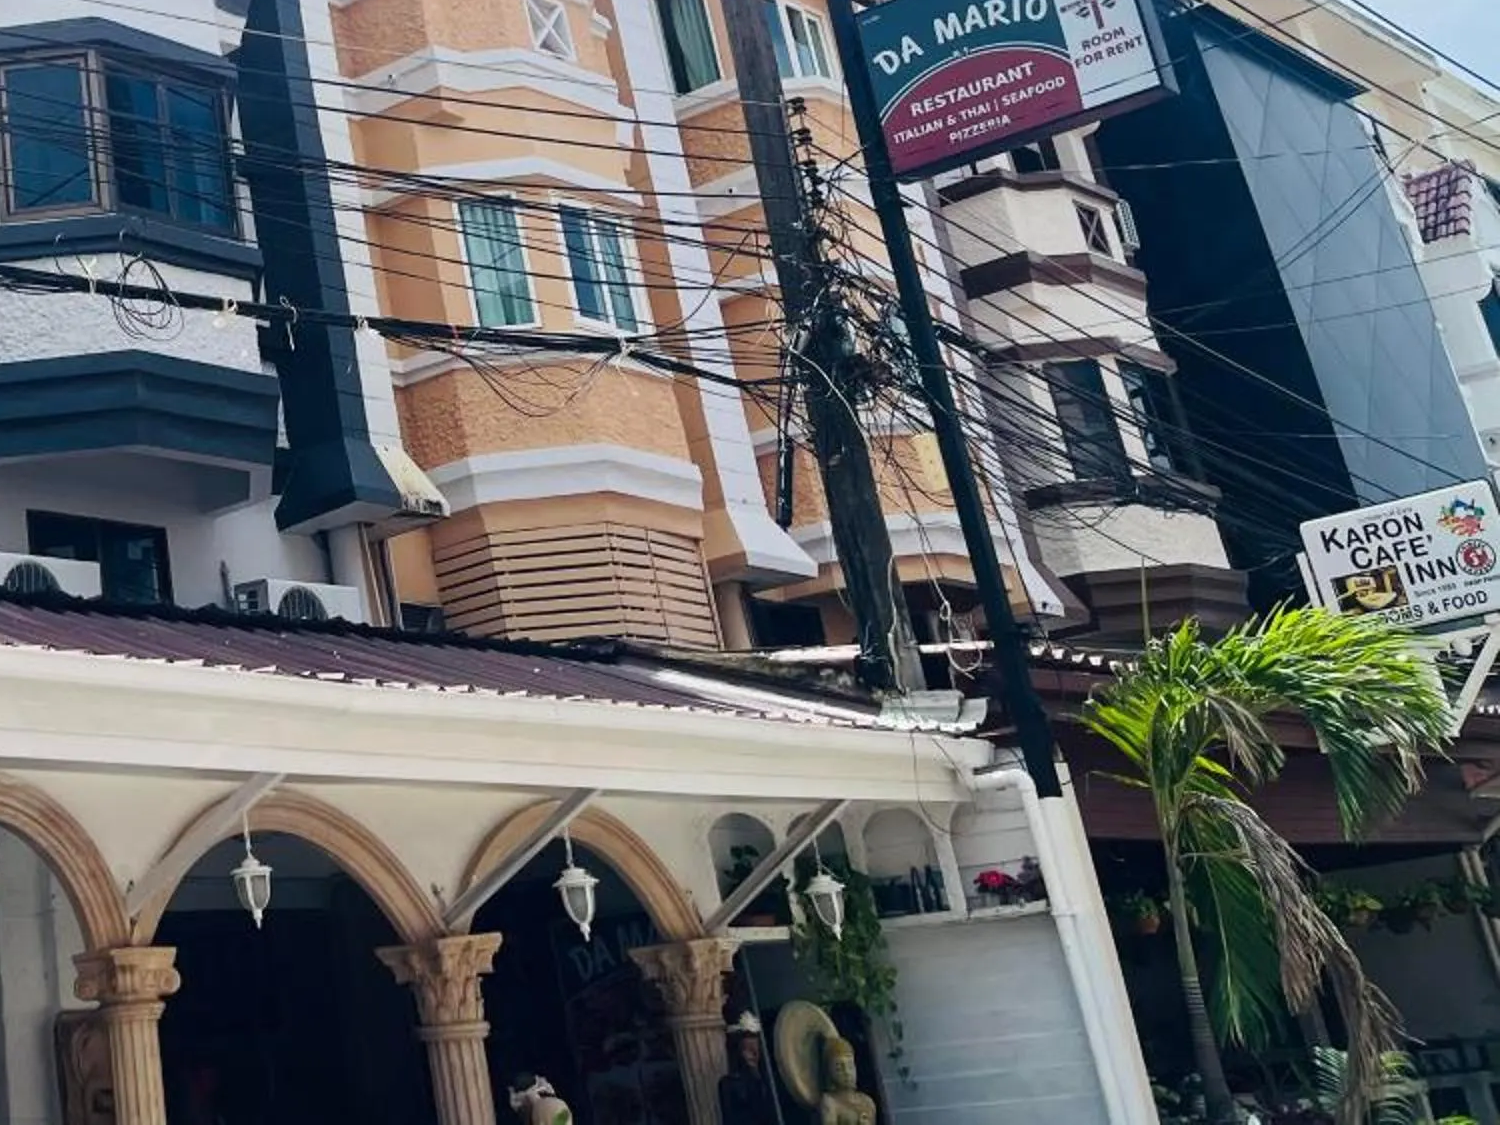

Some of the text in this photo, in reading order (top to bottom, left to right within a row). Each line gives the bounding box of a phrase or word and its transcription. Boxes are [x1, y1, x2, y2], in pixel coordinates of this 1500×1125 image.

[872, 35, 925, 75] DA
[1074, 34, 1143, 68] FOR RENT
[1080, 26, 1125, 51] ROOM
[910, 61, 1034, 117] RESTAURANT
[893, 119, 943, 144] ITALIAN
[947, 112, 957, 126] &
[959, 101, 991, 122] THAI
[1002, 76, 1066, 106] SEAFOOD
[949, 115, 1011, 144] PIZZERIA
[1320, 512, 1424, 553] KARON
[1404, 556, 1458, 585] INN
[1428, 601, 1440, 615] &
[1441, 590, 1488, 611] FOOD
